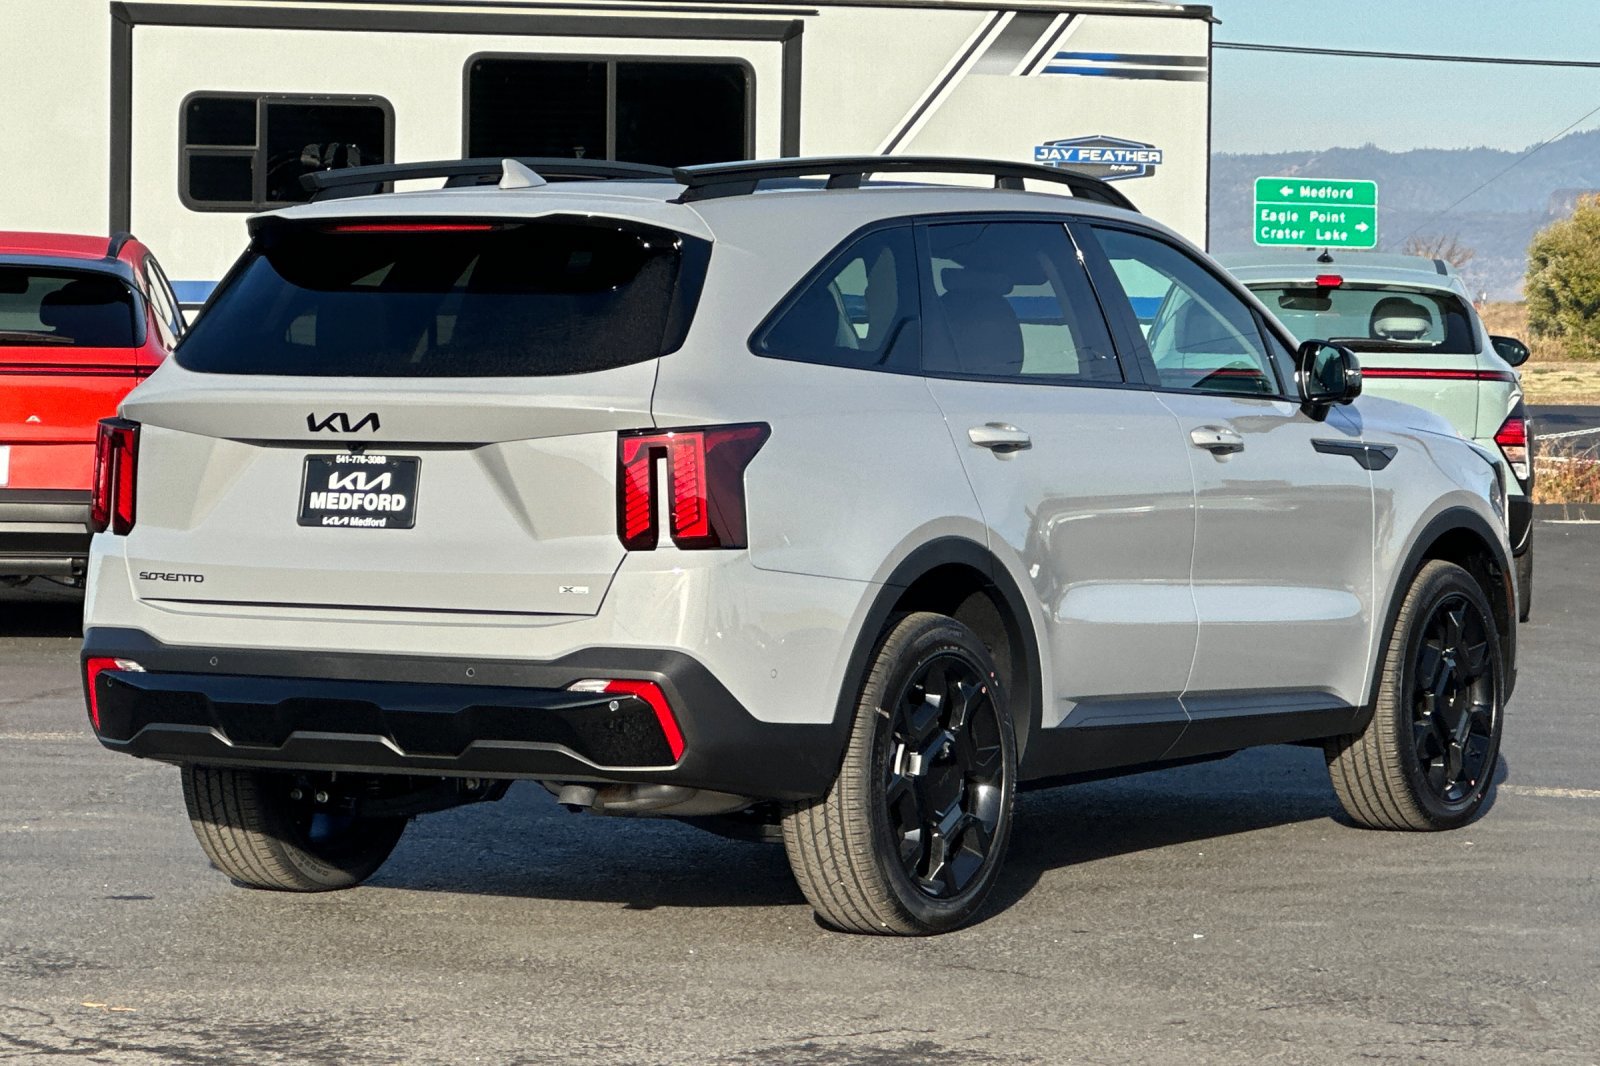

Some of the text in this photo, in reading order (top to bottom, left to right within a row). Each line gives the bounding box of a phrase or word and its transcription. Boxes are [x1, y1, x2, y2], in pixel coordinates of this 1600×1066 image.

[1036, 148, 1160, 162] JAY FEATHER
[1299, 185, 1354, 200] Medford
[1261, 209, 1346, 225] Eagle Point
[1261, 226, 1348, 241] Crater Lake
[306, 412, 381, 433] KIA
[328, 471, 391, 491] KIA
[309, 491, 406, 512] MEDFORD
[322, 516, 386, 527] KIA Medford
[139, 571, 204, 584] SORENTO
